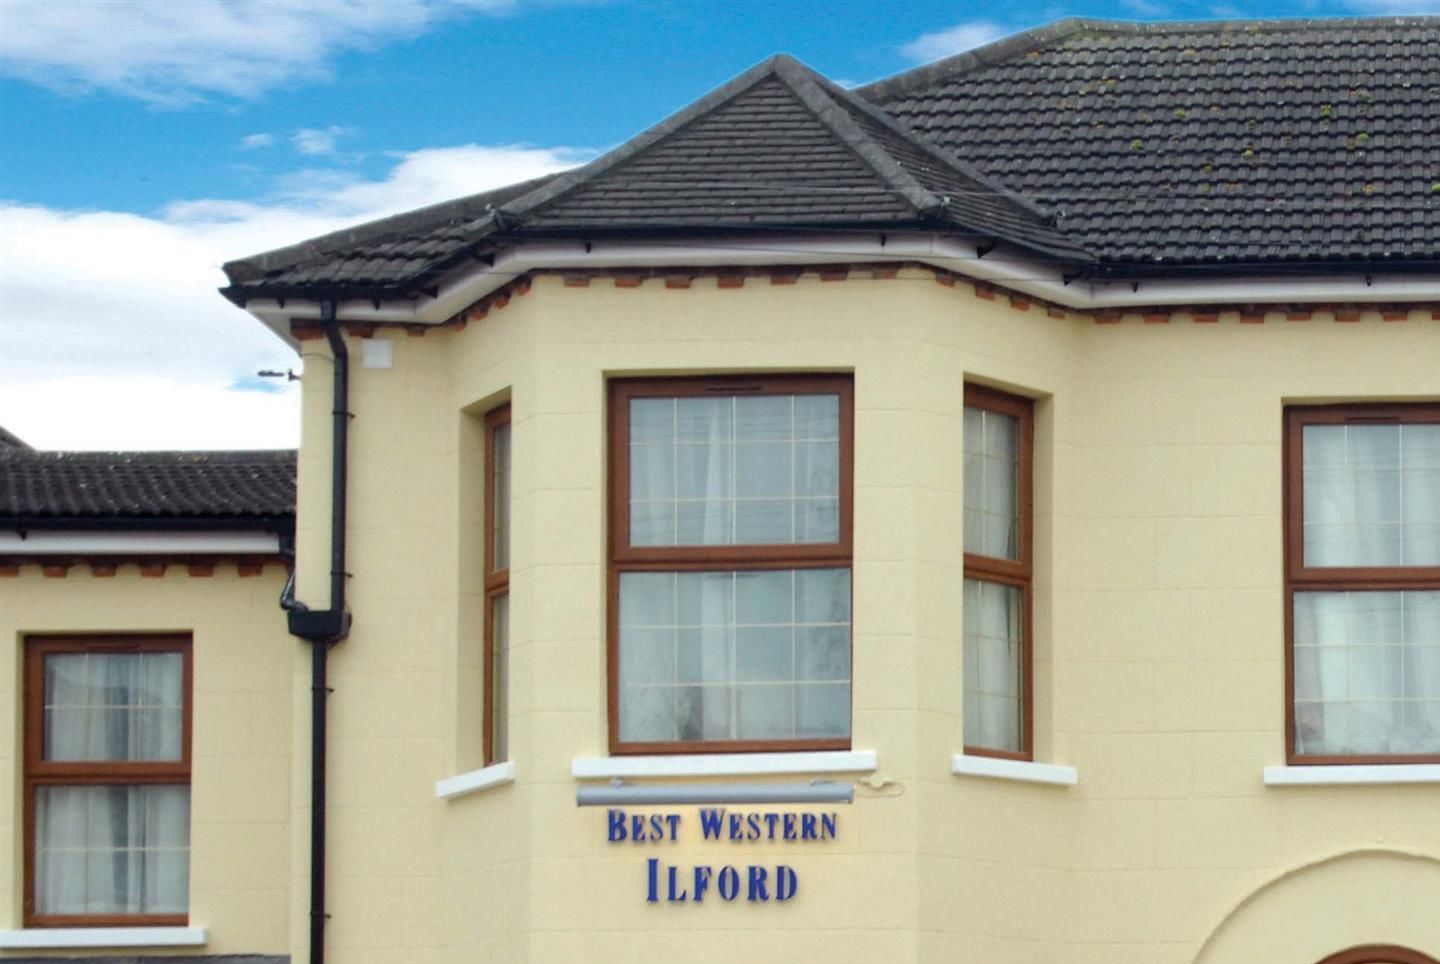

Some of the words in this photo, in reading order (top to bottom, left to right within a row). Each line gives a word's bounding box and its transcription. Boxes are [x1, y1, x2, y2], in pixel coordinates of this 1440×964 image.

[607, 808, 682, 842] BEST
[699, 807, 838, 841] WESTERN
[646, 858, 798, 902] ILFORD
